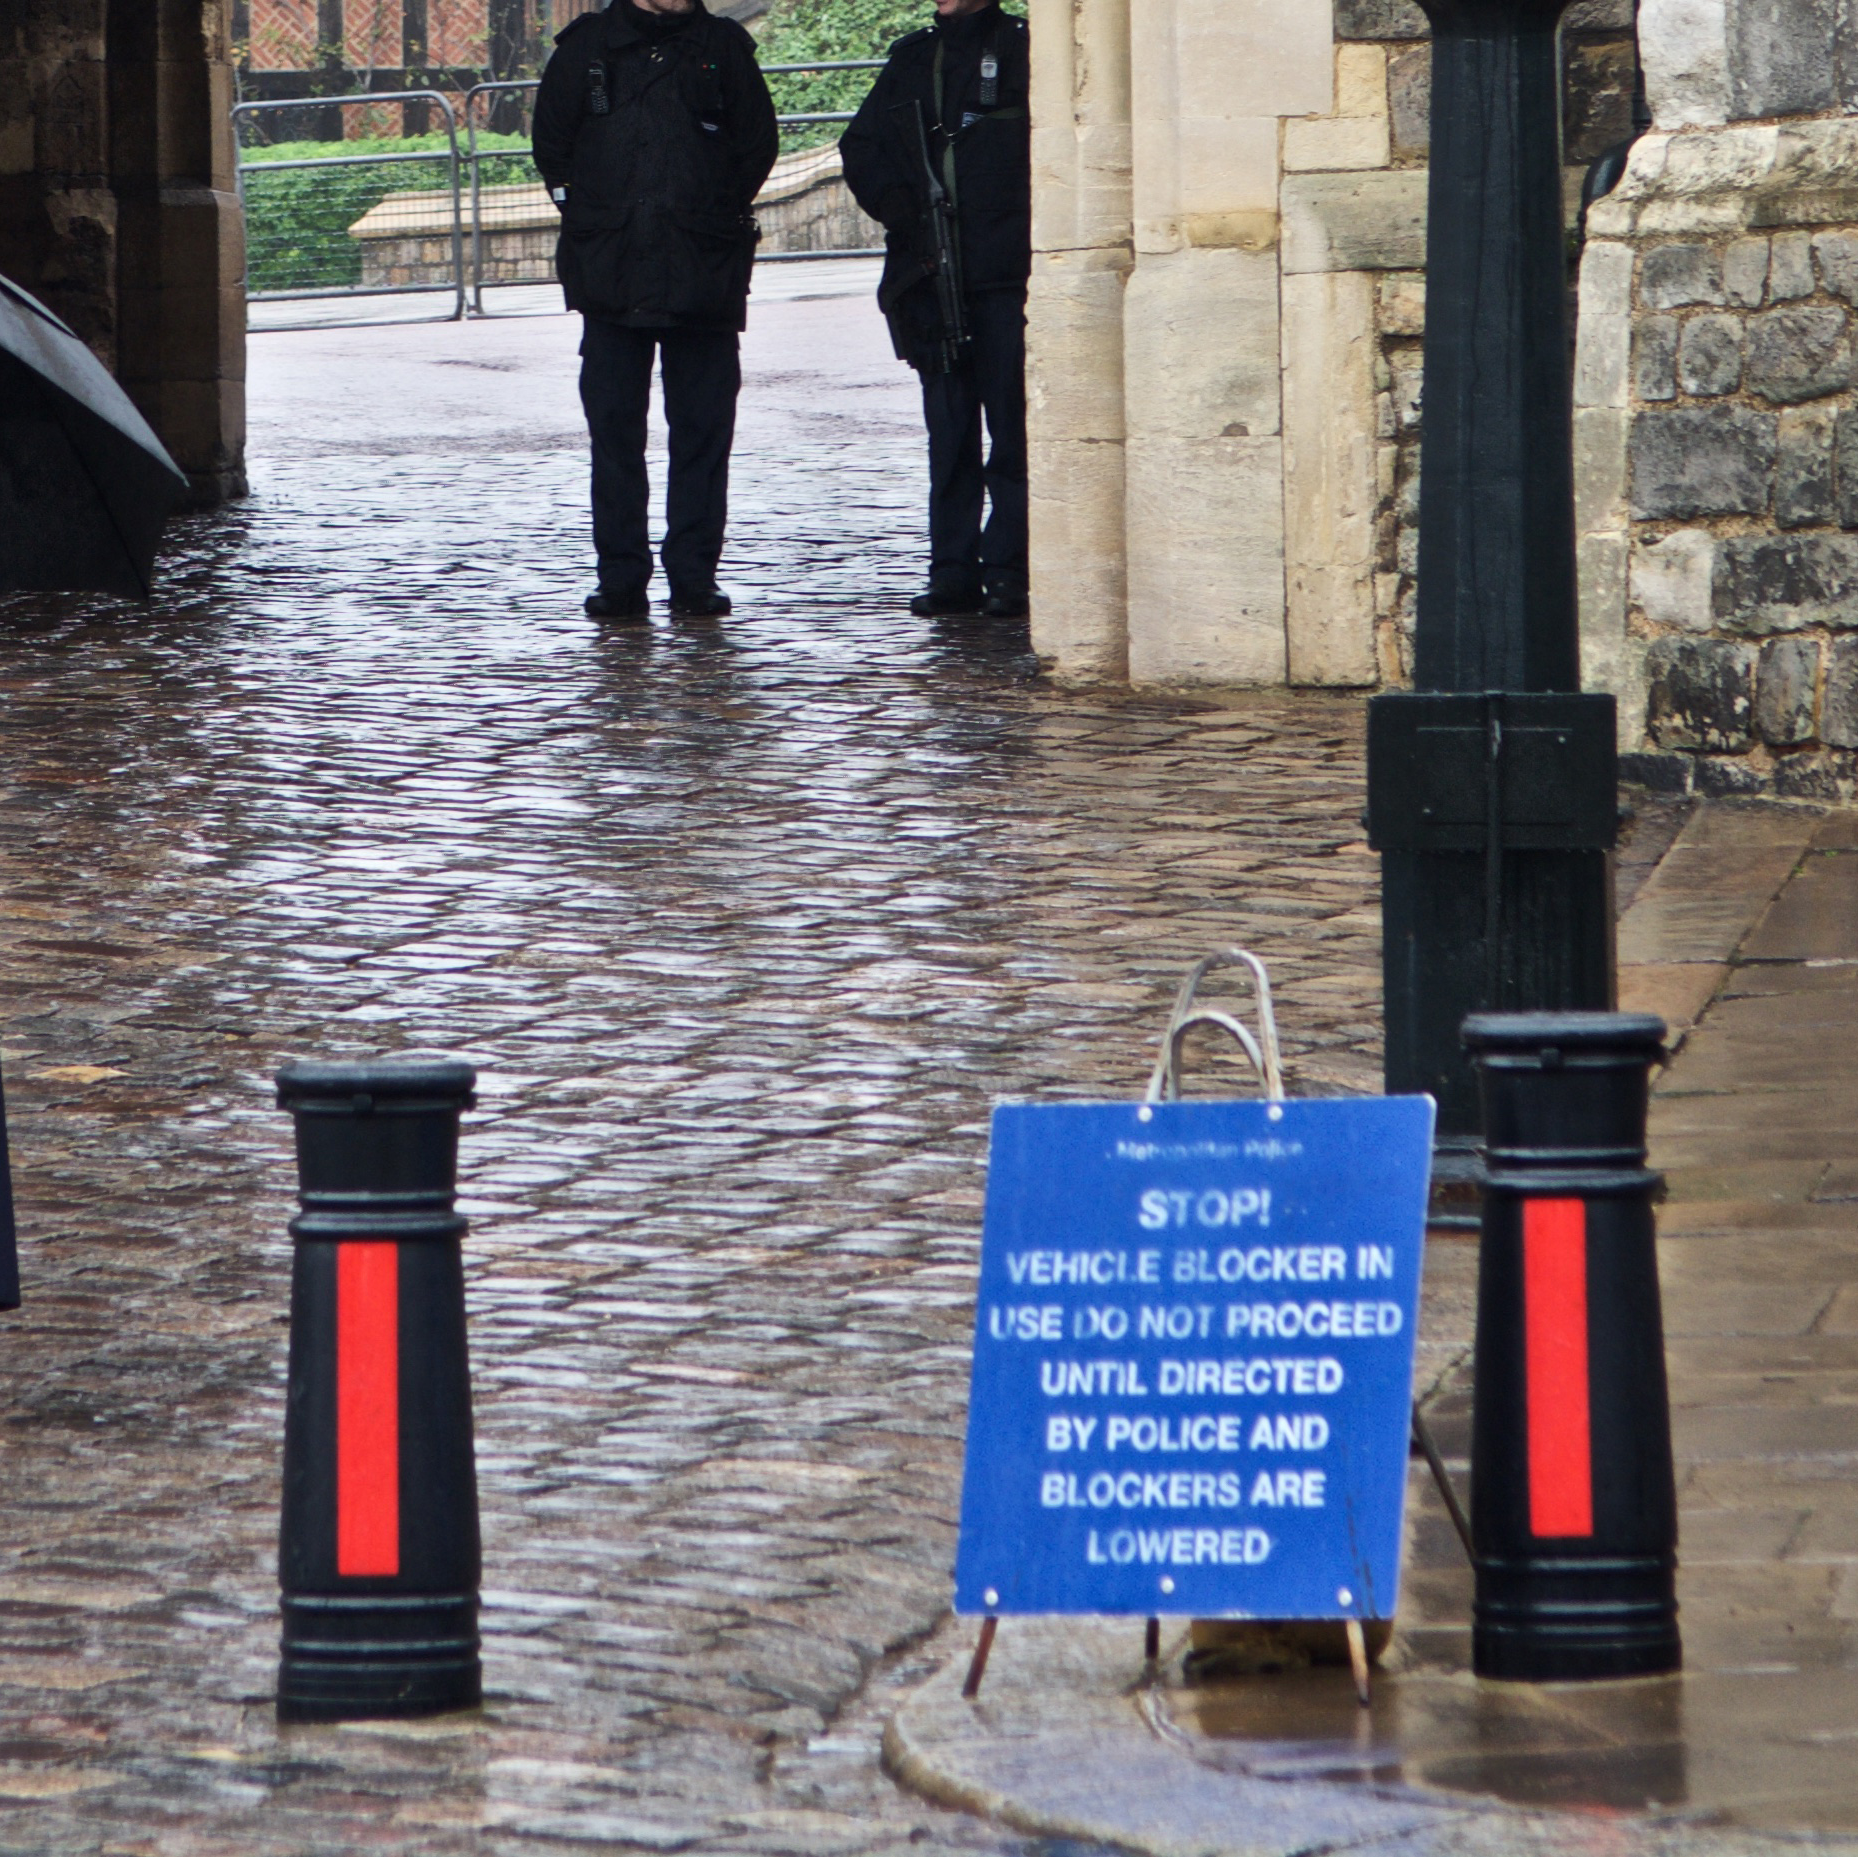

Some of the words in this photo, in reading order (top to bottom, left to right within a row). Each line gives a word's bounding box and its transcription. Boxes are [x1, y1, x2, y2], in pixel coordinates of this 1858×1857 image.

[1138, 1189, 1271, 1229] STOP!
[1006, 1250, 1161, 1284] VEHICLE
[1172, 1247, 1346, 1282] BLOCKER
[1357, 1246, 1393, 1279] IN
[990, 1306, 1063, 1340] USE
[1073, 1305, 1129, 1339] DO
[1142, 1304, 1214, 1338] NOT
[1226, 1302, 1404, 1337] PROCEED
[1042, 1361, 1148, 1396] UNTIL
[1159, 1358, 1343, 1394] DIRECTED
[1046, 1416, 1097, 1451] BY
[1107, 1415, 1241, 1452] POLICE
[1249, 1414, 1330, 1451] AND
[1041, 1471, 1241, 1508] BLOCKERS
[1250, 1470, 1327, 1508] ARE
[1087, 1528, 1272, 1565] LOWERED
